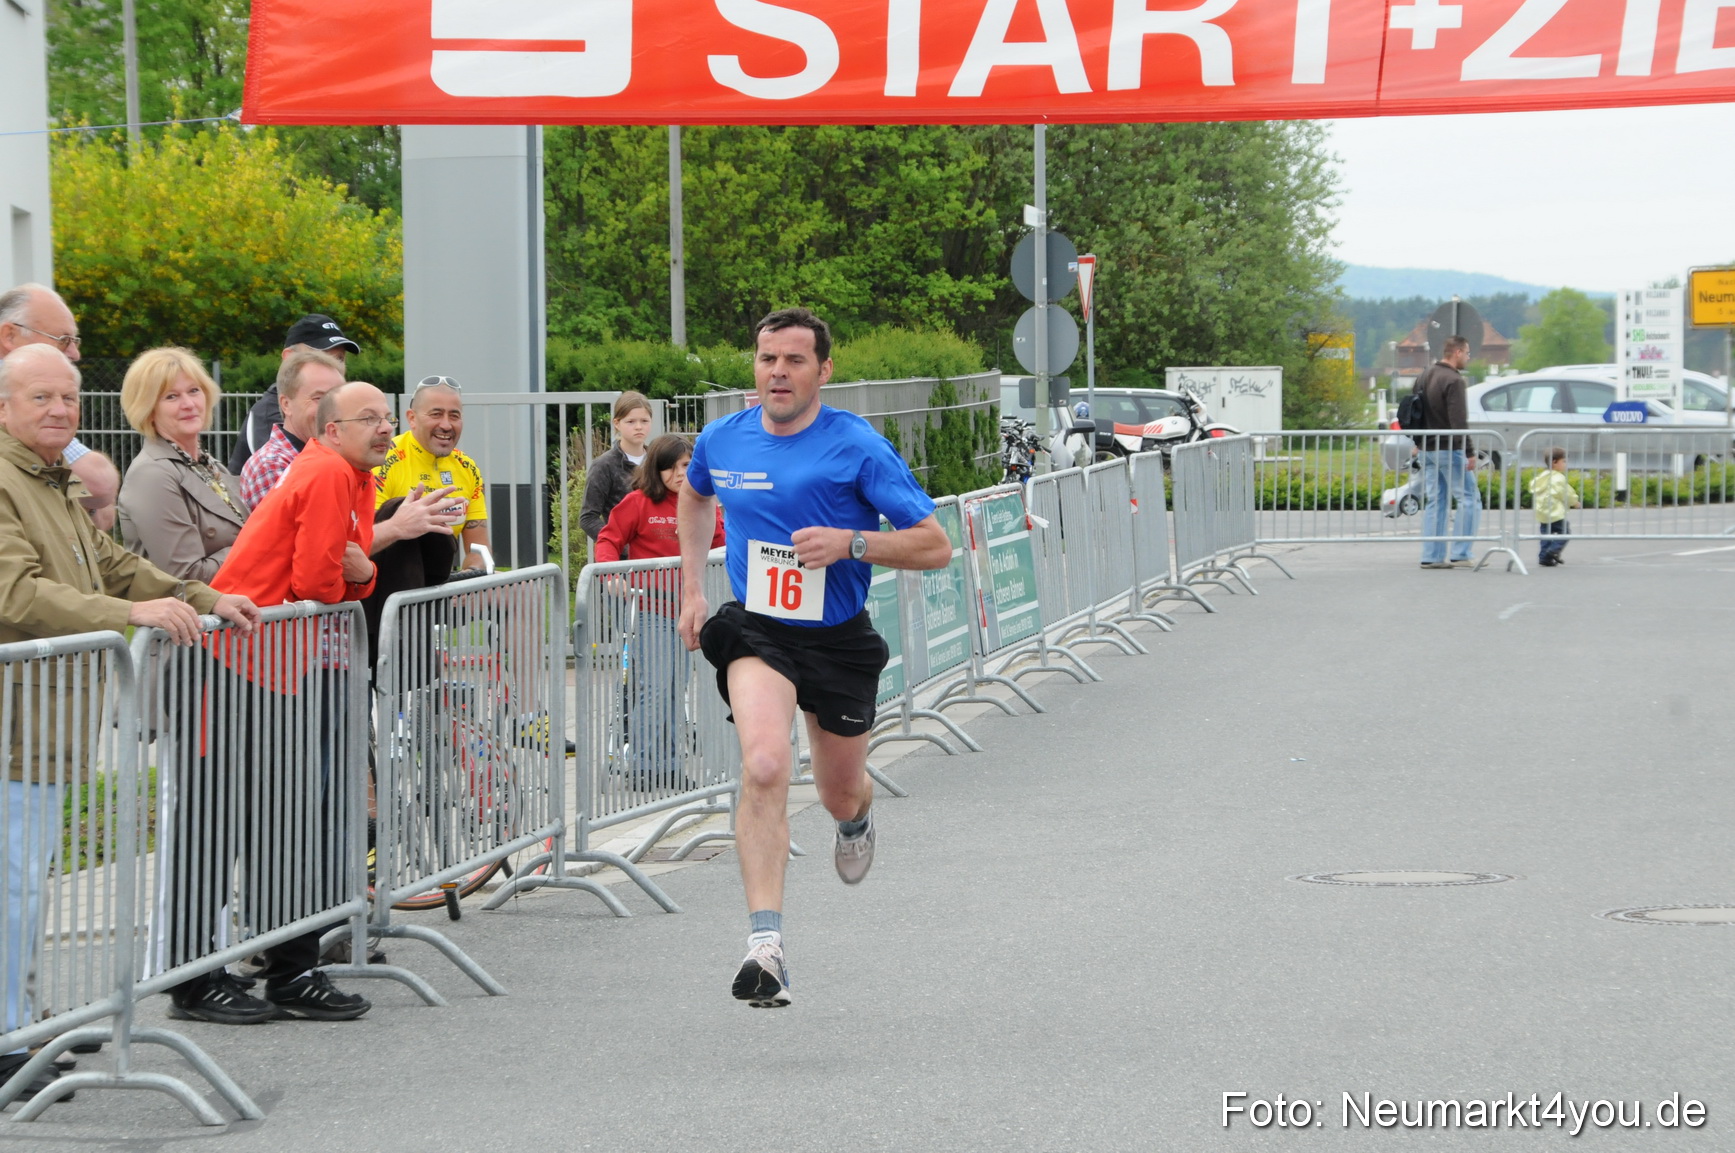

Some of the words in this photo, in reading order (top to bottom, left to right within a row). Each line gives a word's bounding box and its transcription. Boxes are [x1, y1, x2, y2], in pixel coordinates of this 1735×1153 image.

[1612, 411, 1644, 422] VOLVO
[760, 546, 795, 560] MEYER
[760, 555, 796, 566] WERBUNG
[766, 566, 803, 611] 16
